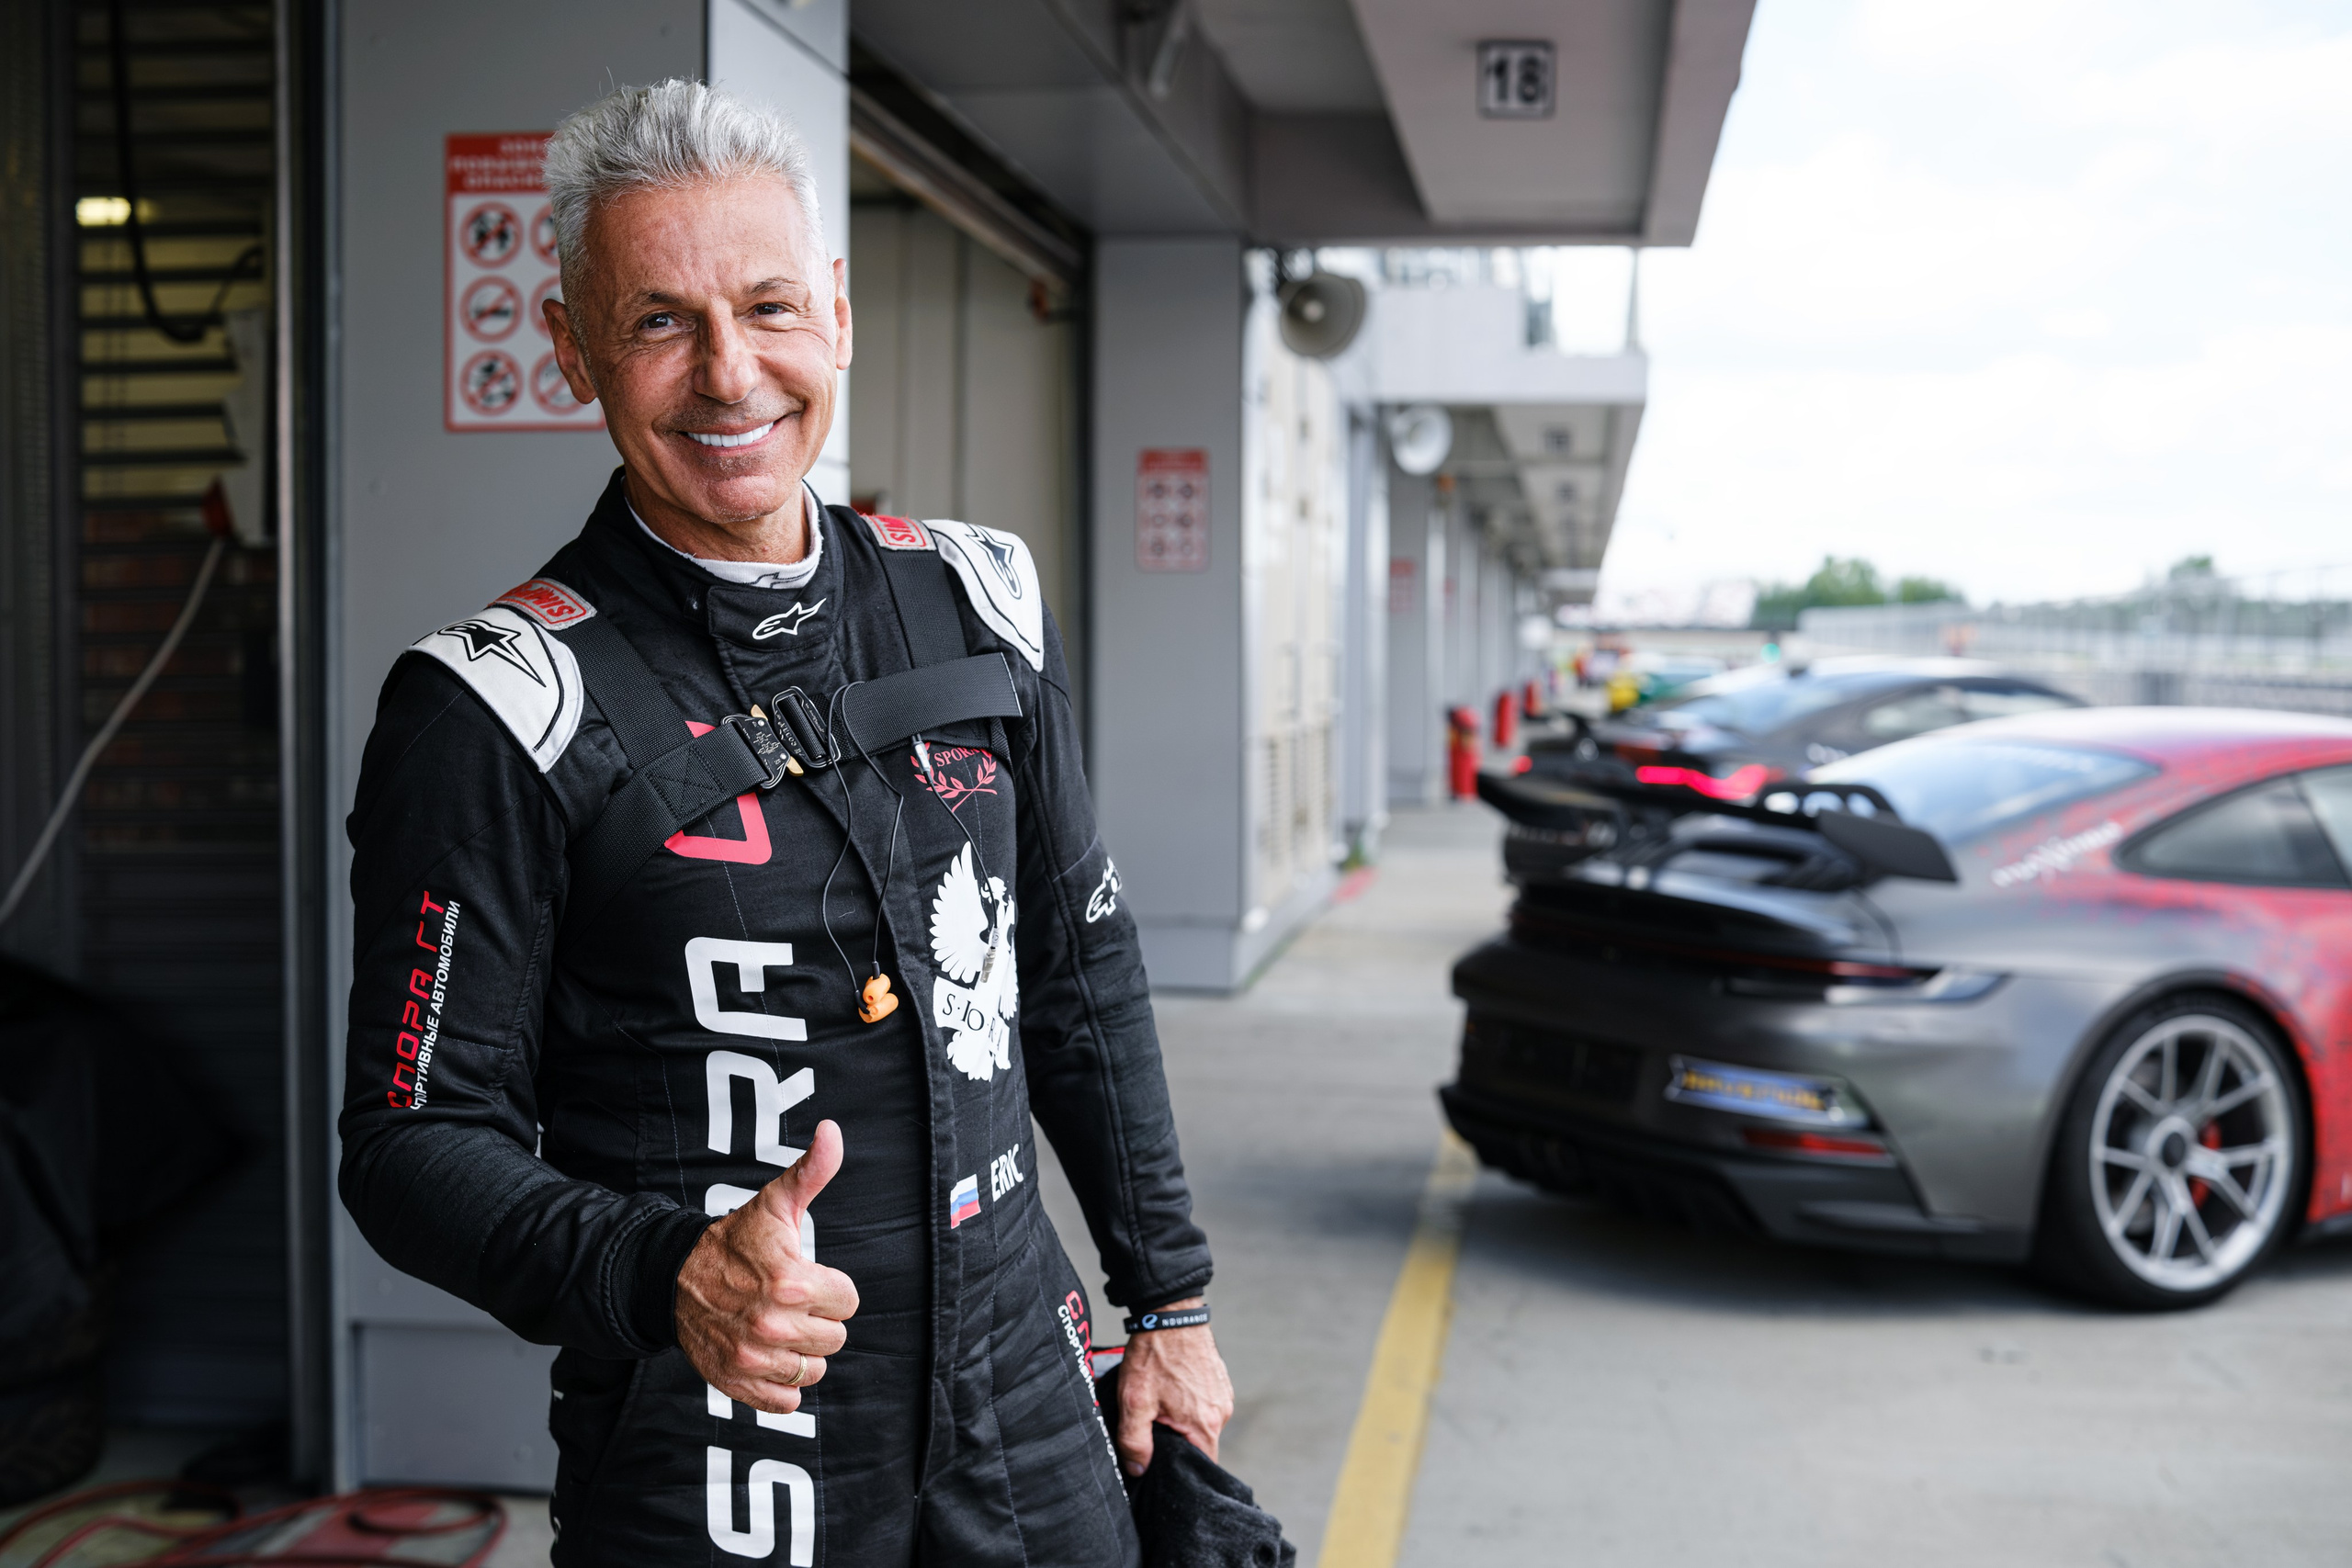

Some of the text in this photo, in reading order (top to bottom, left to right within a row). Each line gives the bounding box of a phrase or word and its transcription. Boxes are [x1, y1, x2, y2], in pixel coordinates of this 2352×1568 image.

[416, 890, 445, 953] ГТ
[430, 899, 460, 1015] АВТОМОБИЛИ
[989, 1143, 1024, 1202] ERIC
